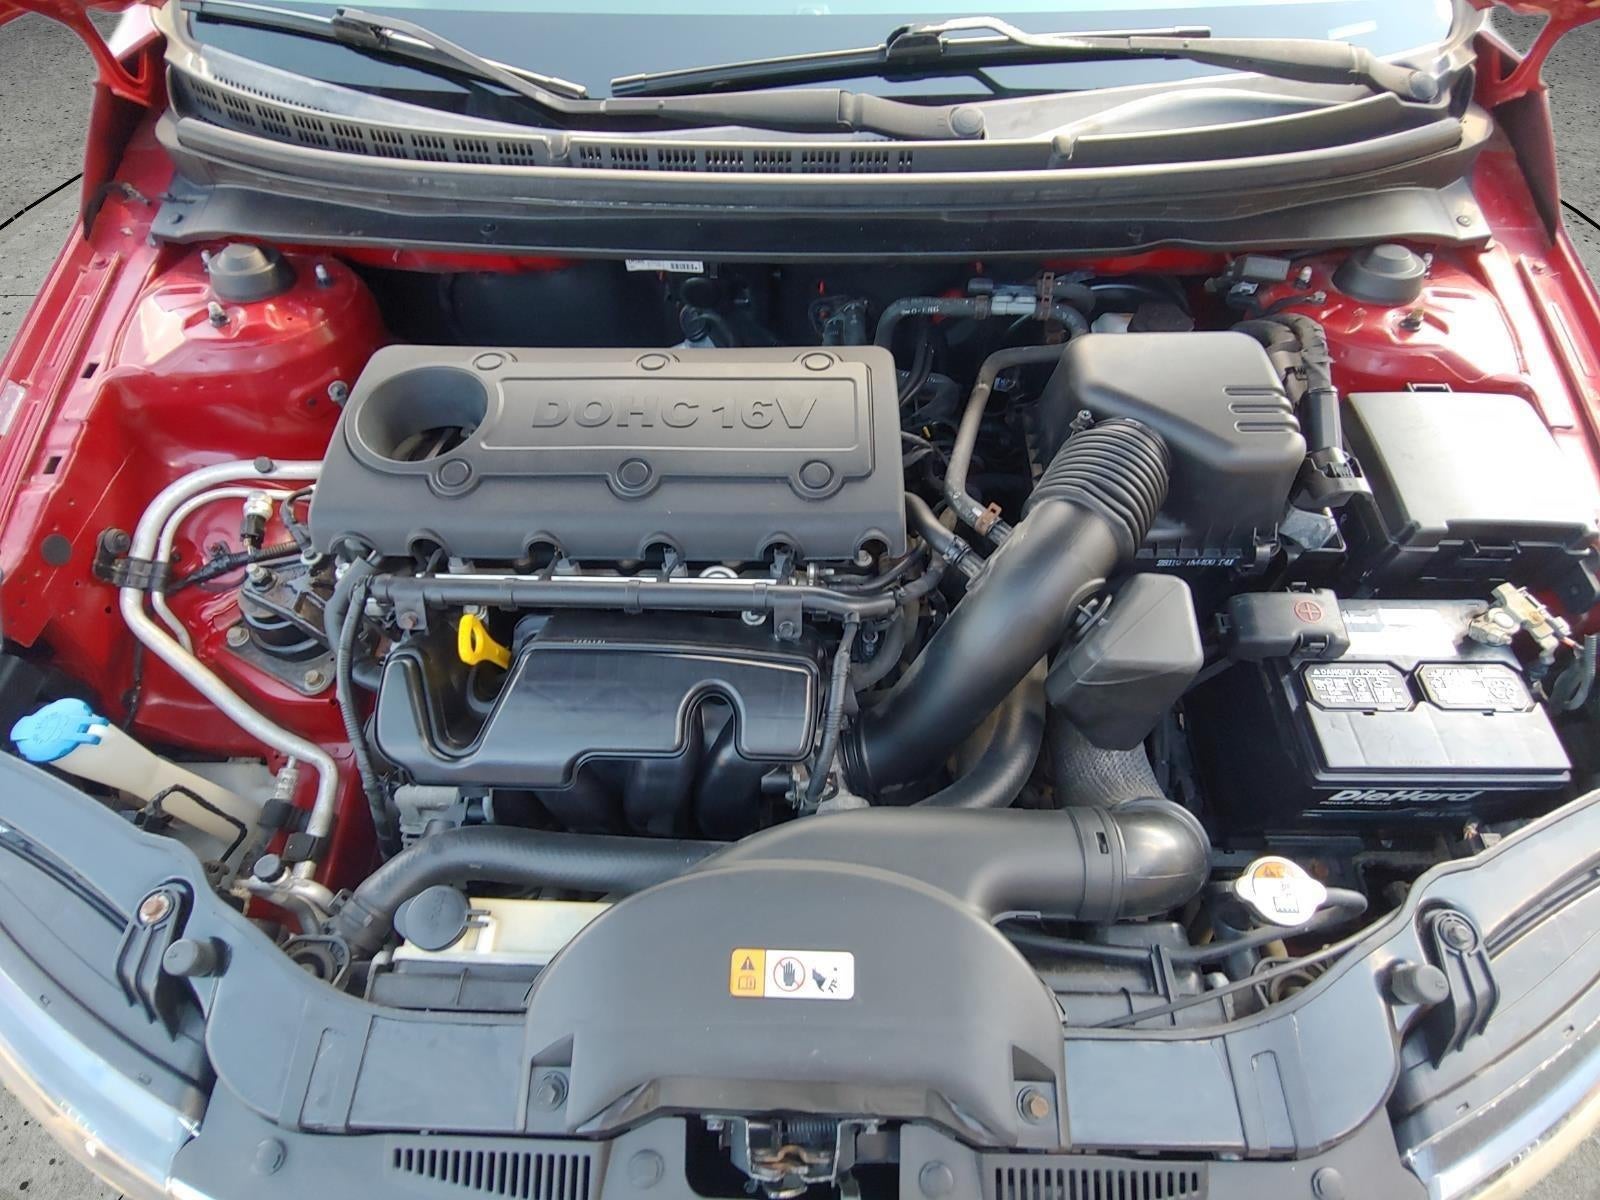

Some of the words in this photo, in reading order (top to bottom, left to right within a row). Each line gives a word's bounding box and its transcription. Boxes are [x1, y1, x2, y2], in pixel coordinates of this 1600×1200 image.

[532, 396, 699, 428] DOHC
[712, 396, 817, 429] 16V
[1328, 789, 1486, 801] DieHard
